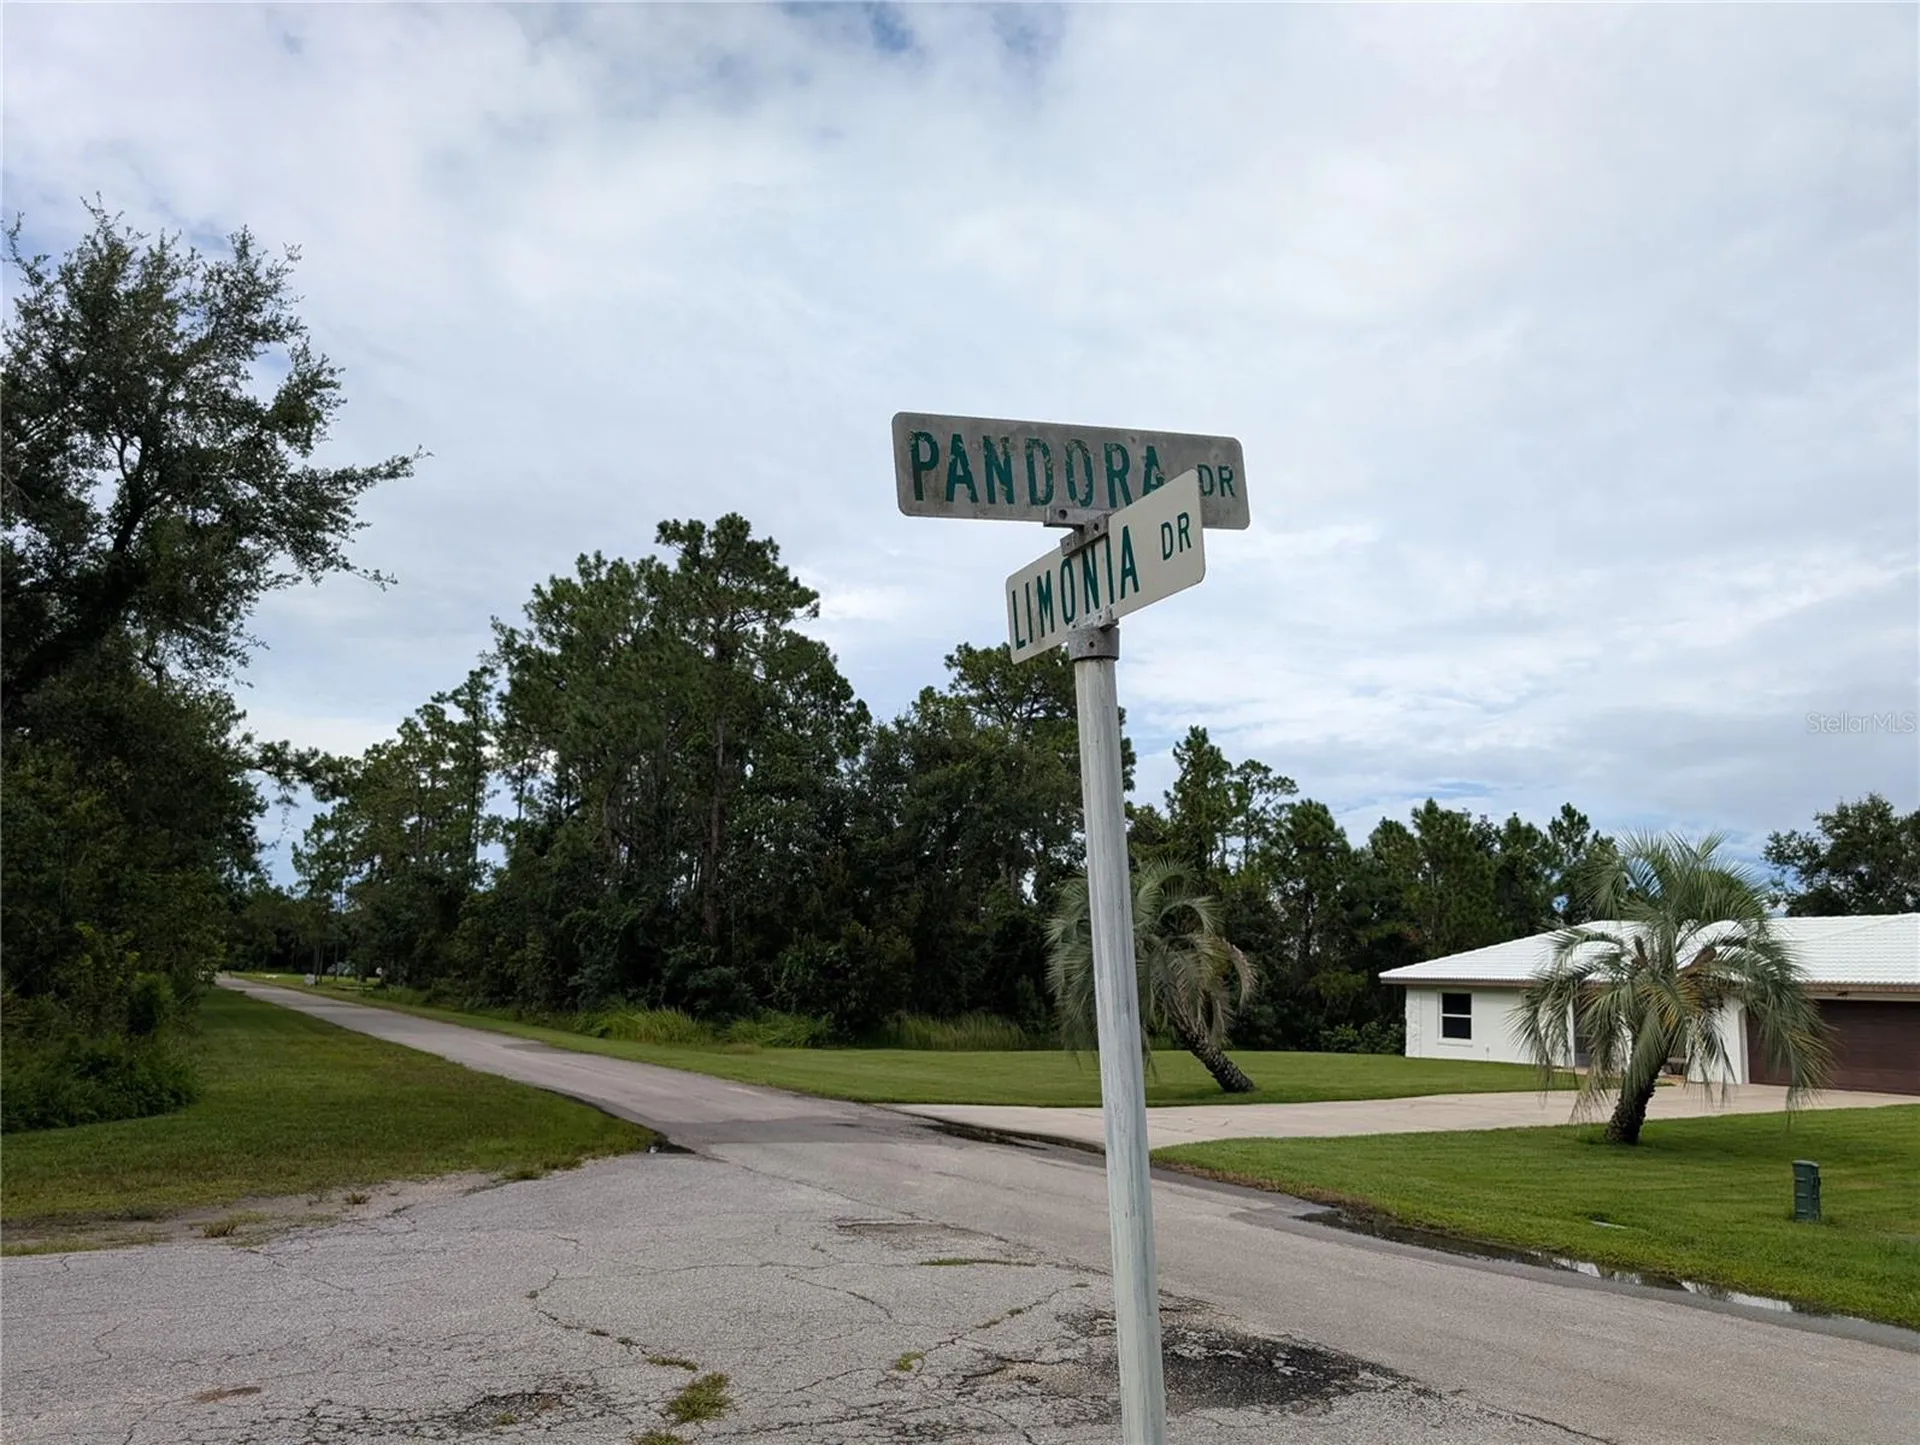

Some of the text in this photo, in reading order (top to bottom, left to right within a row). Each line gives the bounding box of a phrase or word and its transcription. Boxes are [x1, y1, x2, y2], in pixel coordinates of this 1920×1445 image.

[909, 431, 1237, 507] PANDORA DR
[1011, 511, 1193, 650] LIMONIA DR
